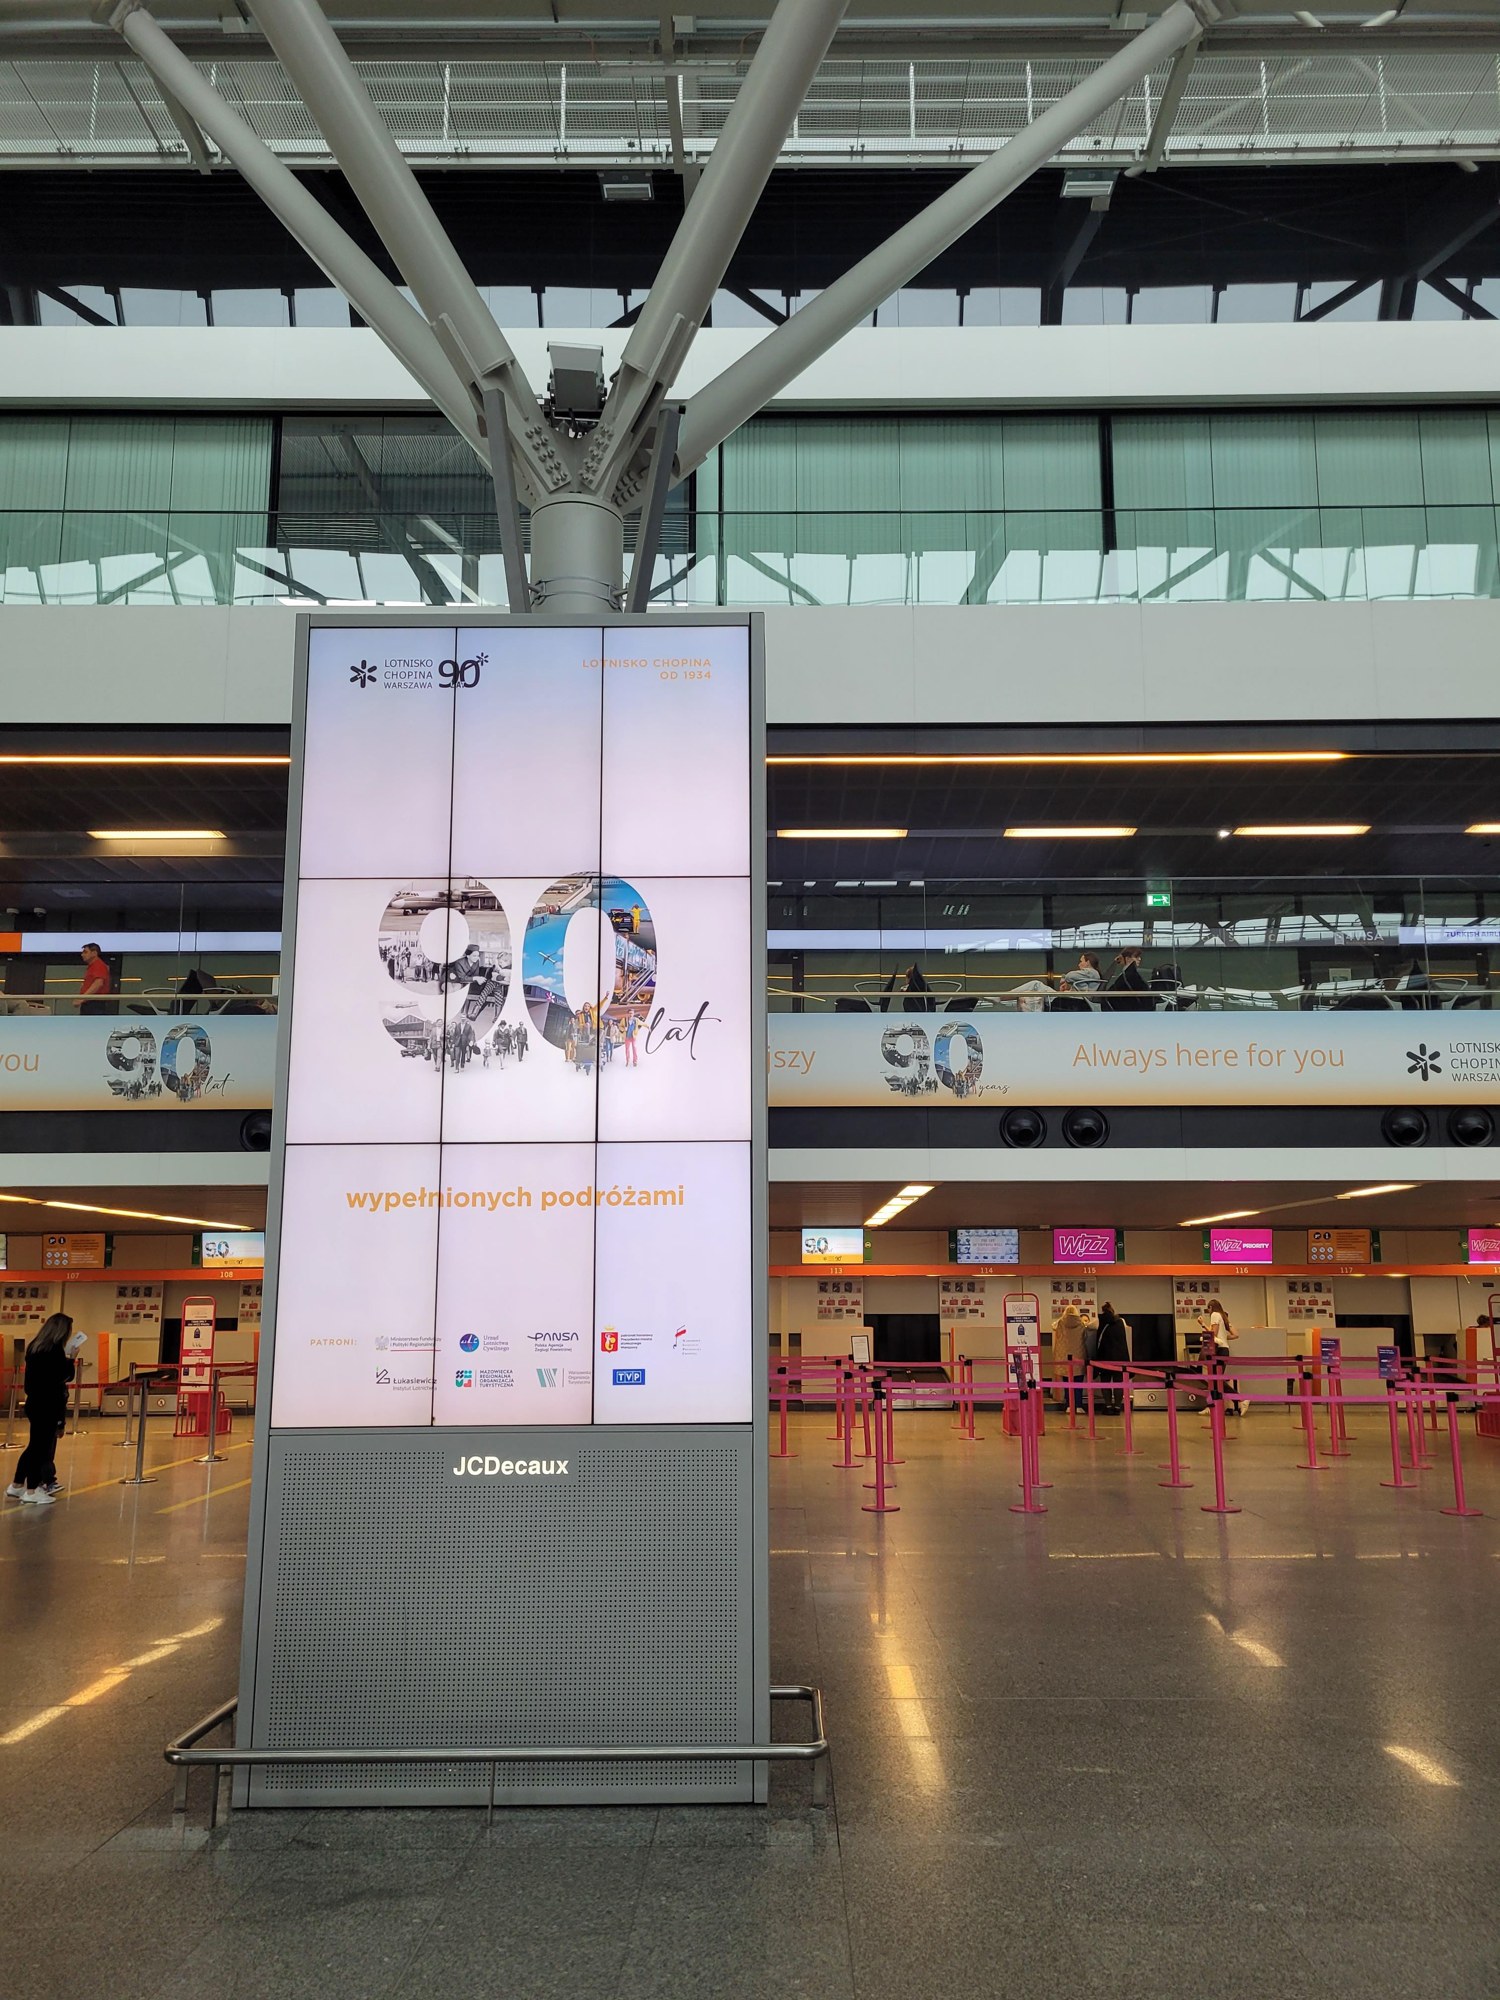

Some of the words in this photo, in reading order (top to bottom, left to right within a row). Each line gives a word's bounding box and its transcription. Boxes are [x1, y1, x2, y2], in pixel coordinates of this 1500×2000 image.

[384, 659, 434, 668] LOTNISKO
[582, 659, 648, 668] LOTNISKO
[653, 658, 712, 668] CHOPINA
[384, 671, 433, 680] CHOPINA
[660, 671, 678, 680] OD
[684, 671, 711, 680] 1934
[378, 870, 660, 1076] 90
[644, 1000, 722, 1061] lat
[103, 1023, 212, 1102] 90
[204, 1073, 235, 1097] lat
[880, 1021, 984, 1099] 90
[1073, 1044, 1168, 1074] Always
[1176, 1043, 1239, 1067] here
[1247, 1043, 1286, 1067] for
[1293, 1050, 1344, 1074] you
[347, 1187, 532, 1212] wypełnionych
[541, 1185, 685, 1210] podróżami
[830, 1267, 843, 1275] 113
[1235, 1267, 1249, 1275] 116
[310, 1338, 358, 1346] PATRONI:
[527, 1332, 579, 1342] PANSA
[618, 1373, 640, 1382] TVP
[453, 1456, 569, 1476] JCDecaux
